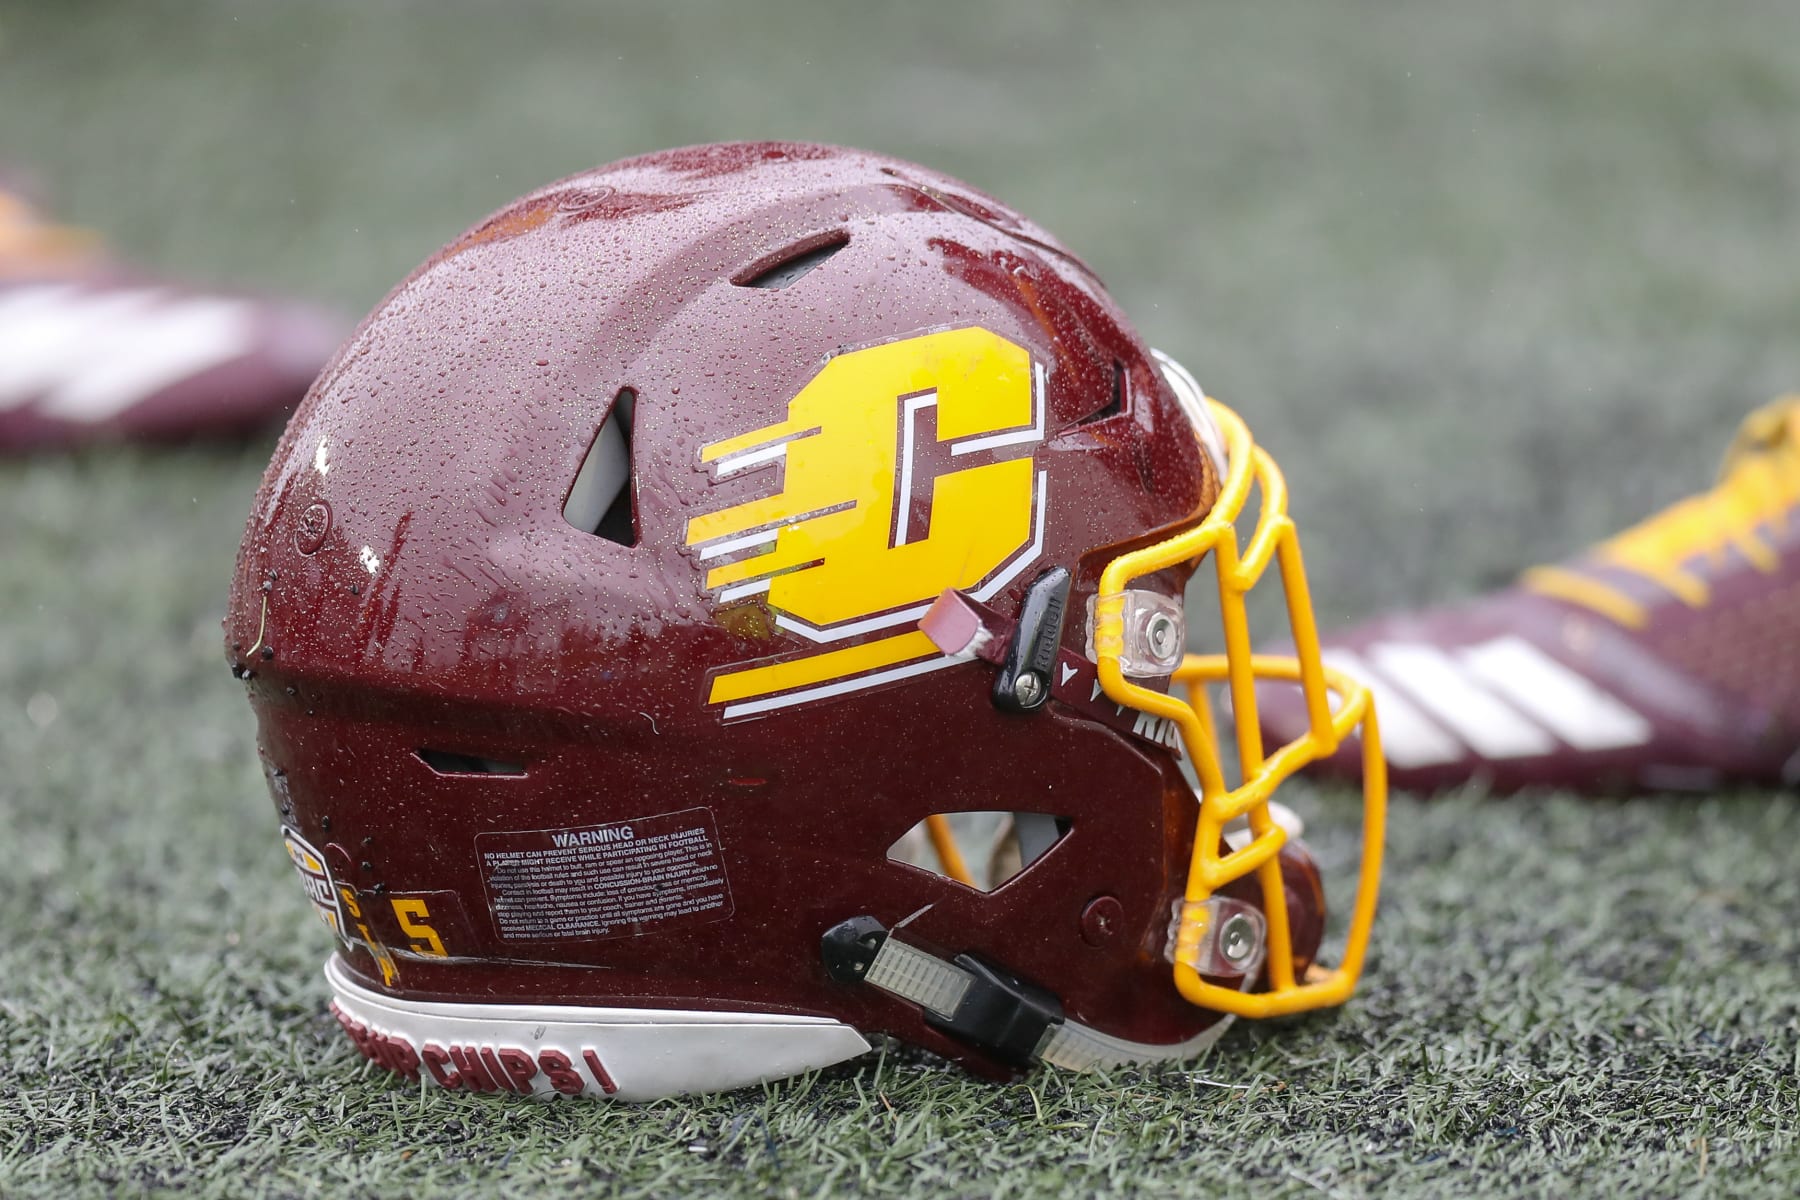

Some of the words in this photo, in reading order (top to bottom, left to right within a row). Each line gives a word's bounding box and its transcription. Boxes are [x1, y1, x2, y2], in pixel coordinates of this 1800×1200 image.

[543, 848, 577, 857] PREVENT
[579, 845, 611, 854] SERIOUS
[613, 841, 634, 849] HEAD
[648, 835, 670, 844] NECK
[671, 828, 705, 840] INJURIES
[546, 856, 577, 864] RECEIVE
[578, 853, 602, 861] WHILE
[603, 845, 657, 858] PARTICIPATING
[668, 835, 709, 848] FOOTBALL
[552, 826, 634, 848] WARNING
[391, 899, 448, 958] 5
